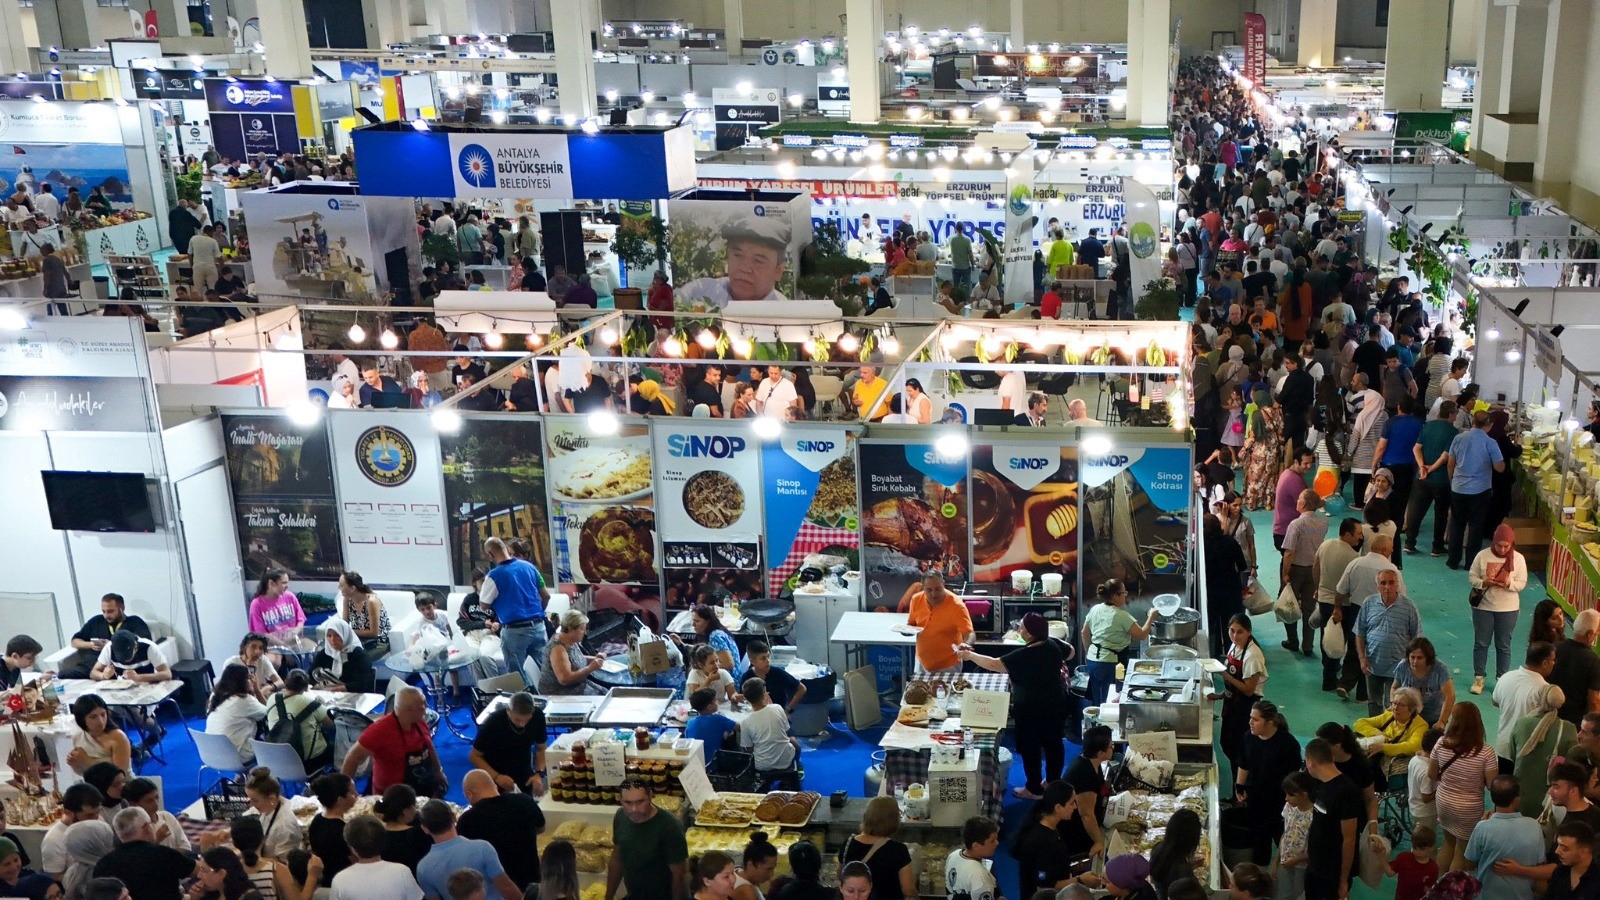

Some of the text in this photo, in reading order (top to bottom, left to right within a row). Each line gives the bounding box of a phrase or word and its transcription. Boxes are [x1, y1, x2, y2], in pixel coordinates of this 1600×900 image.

[496, 148, 540, 159] ANTALYA
[498, 160, 564, 176] BÜYÜKŞEHİR
[500, 174, 551, 189] BELEDİYESİ
[822, 180, 898, 195] ÜRÜNLER
[946, 183, 991, 191] ERZURUM
[871, 474, 902, 484] Boyabat
[1157, 471, 1184, 481] Sinop
[776, 479, 801, 488] Sinop
[871, 484, 916, 492] Sırık Kebabı
[1151, 482, 1183, 490] Kotrası
[777, 486, 807, 496] Mantısı
